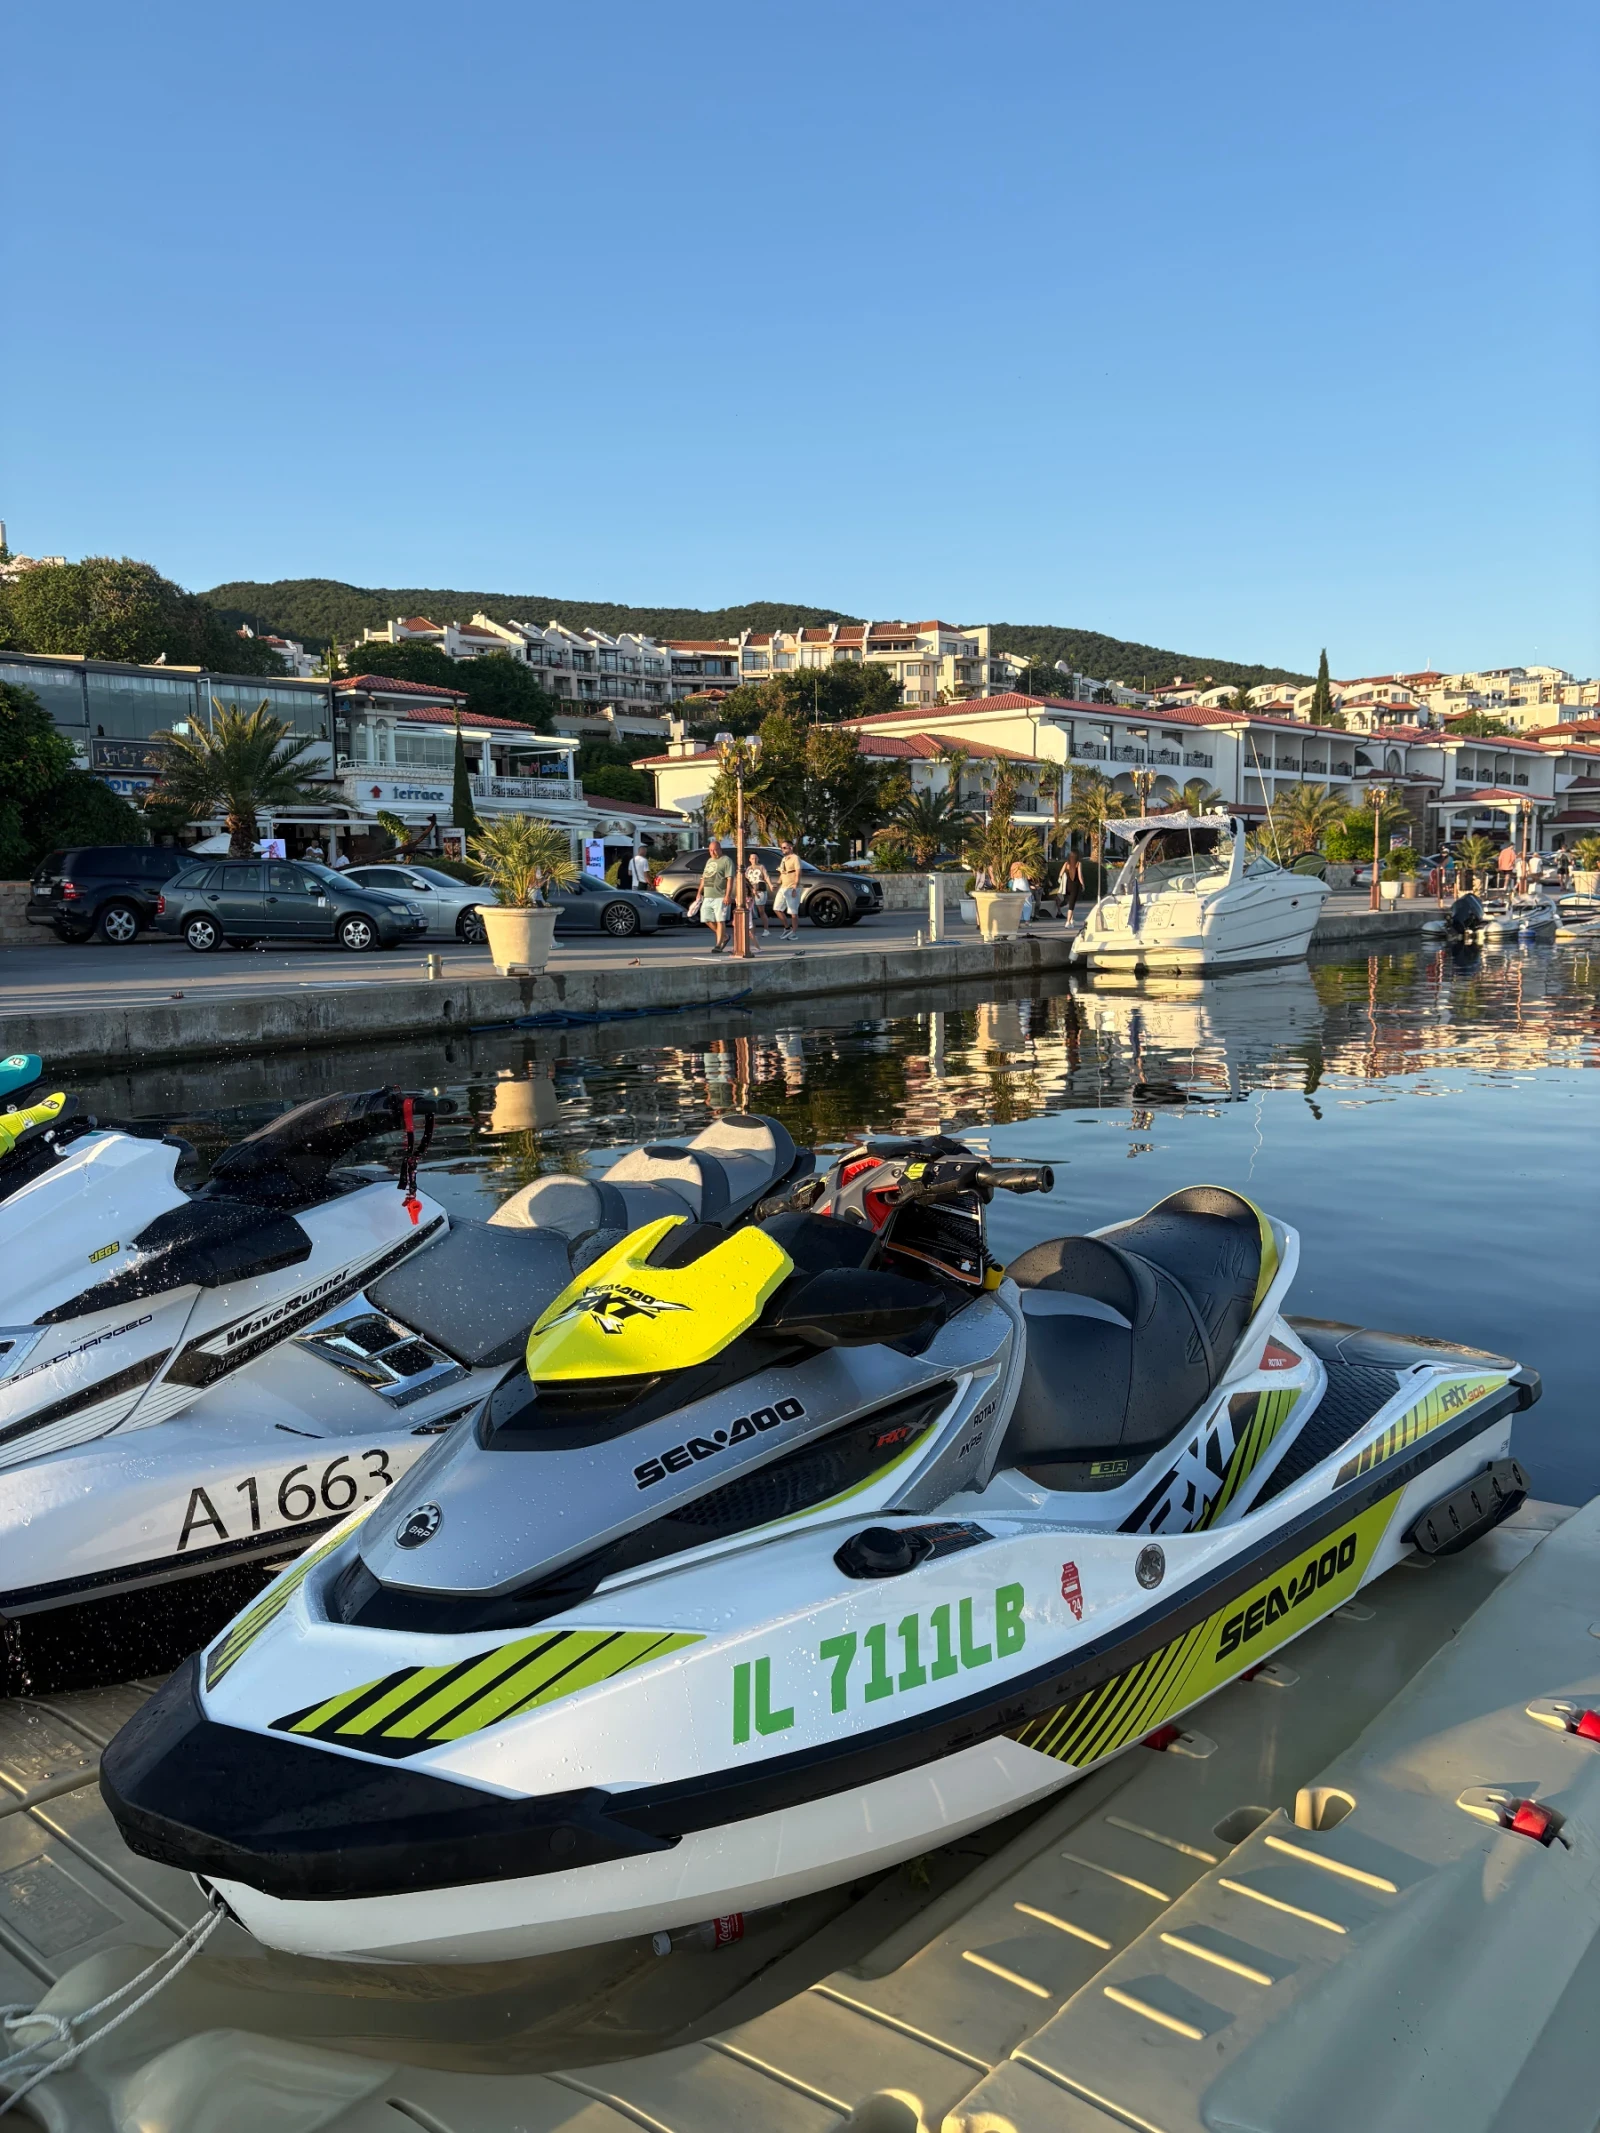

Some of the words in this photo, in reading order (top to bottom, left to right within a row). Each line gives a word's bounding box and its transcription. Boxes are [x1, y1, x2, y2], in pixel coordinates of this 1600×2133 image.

[392, 786, 444, 801] terrace
[89, 1241, 119, 1264] JEGS
[227, 1268, 349, 1346] WaveRunner
[208, 1349, 249, 1379] SUPER
[252, 1321, 297, 1351] VORTEX
[1441, 1384, 1467, 1413] RXT
[1467, 1384, 1487, 1402] 300
[973, 1400, 997, 1428] ROTAX
[408, 1525, 431, 1537] BRP
[1072, 1598, 1082, 1613] 24
[733, 1656, 794, 1745] IL
[820, 1582, 1026, 1714] 7111LB
